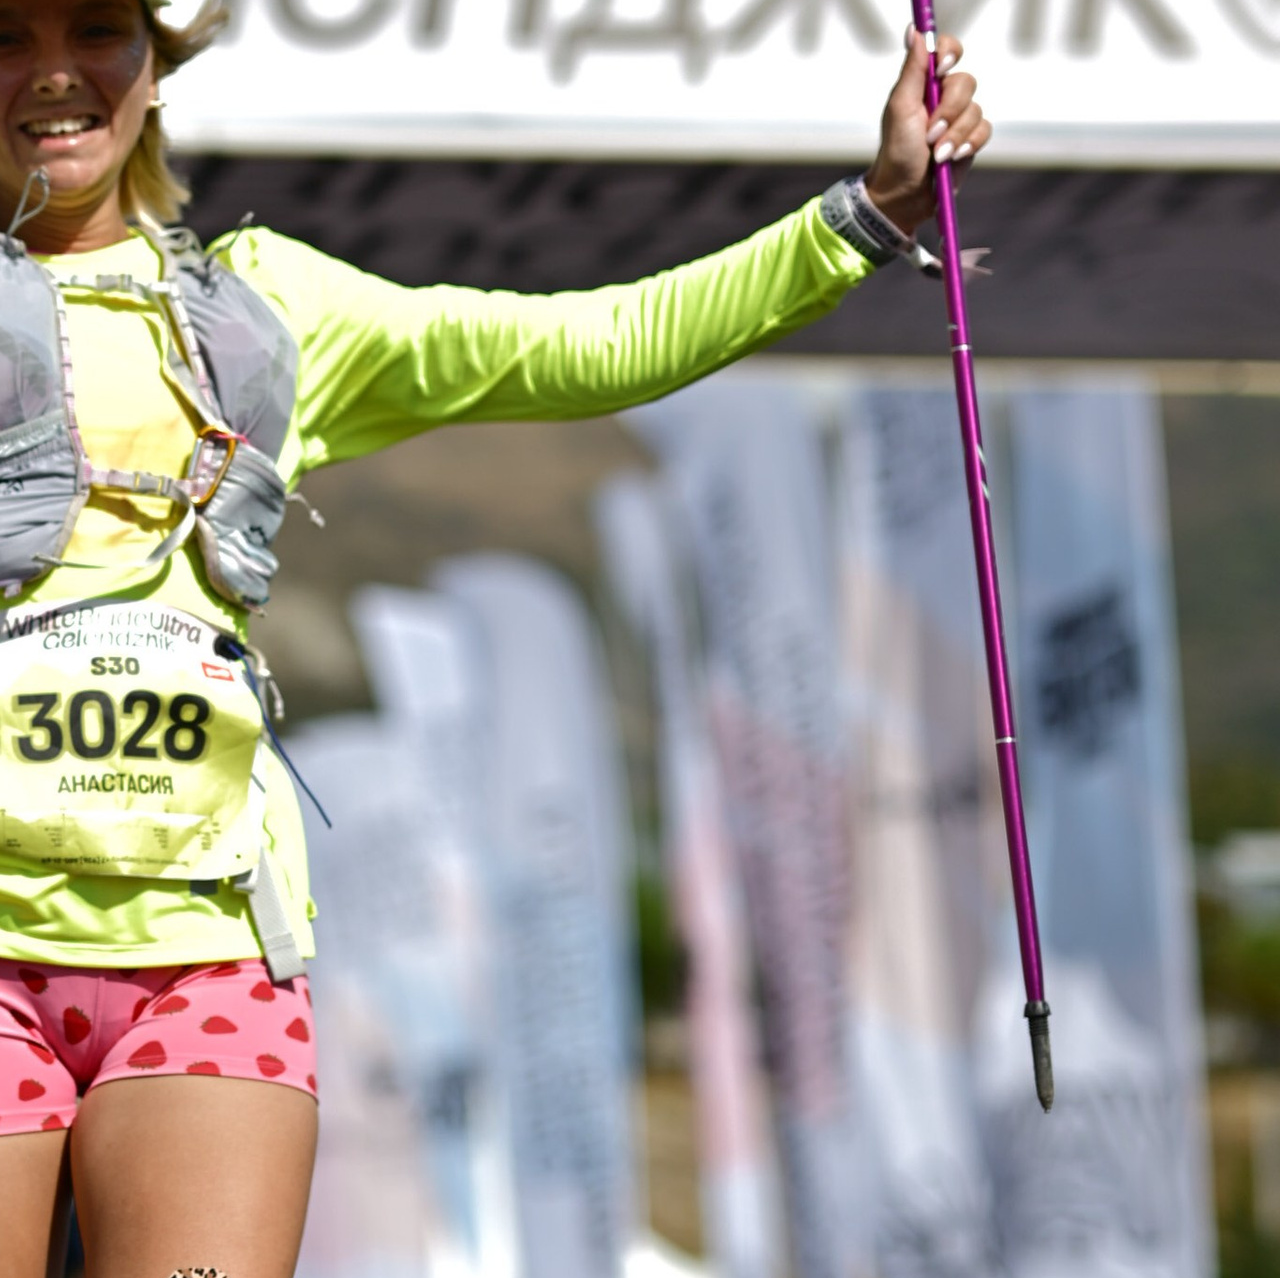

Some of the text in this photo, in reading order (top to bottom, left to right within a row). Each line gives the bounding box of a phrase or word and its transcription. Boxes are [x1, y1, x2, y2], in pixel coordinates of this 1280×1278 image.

[90, 656, 140, 675] S30
[16, 690, 210, 762] 3028
[58, 774, 174, 795] АНАСТАСИЯ
